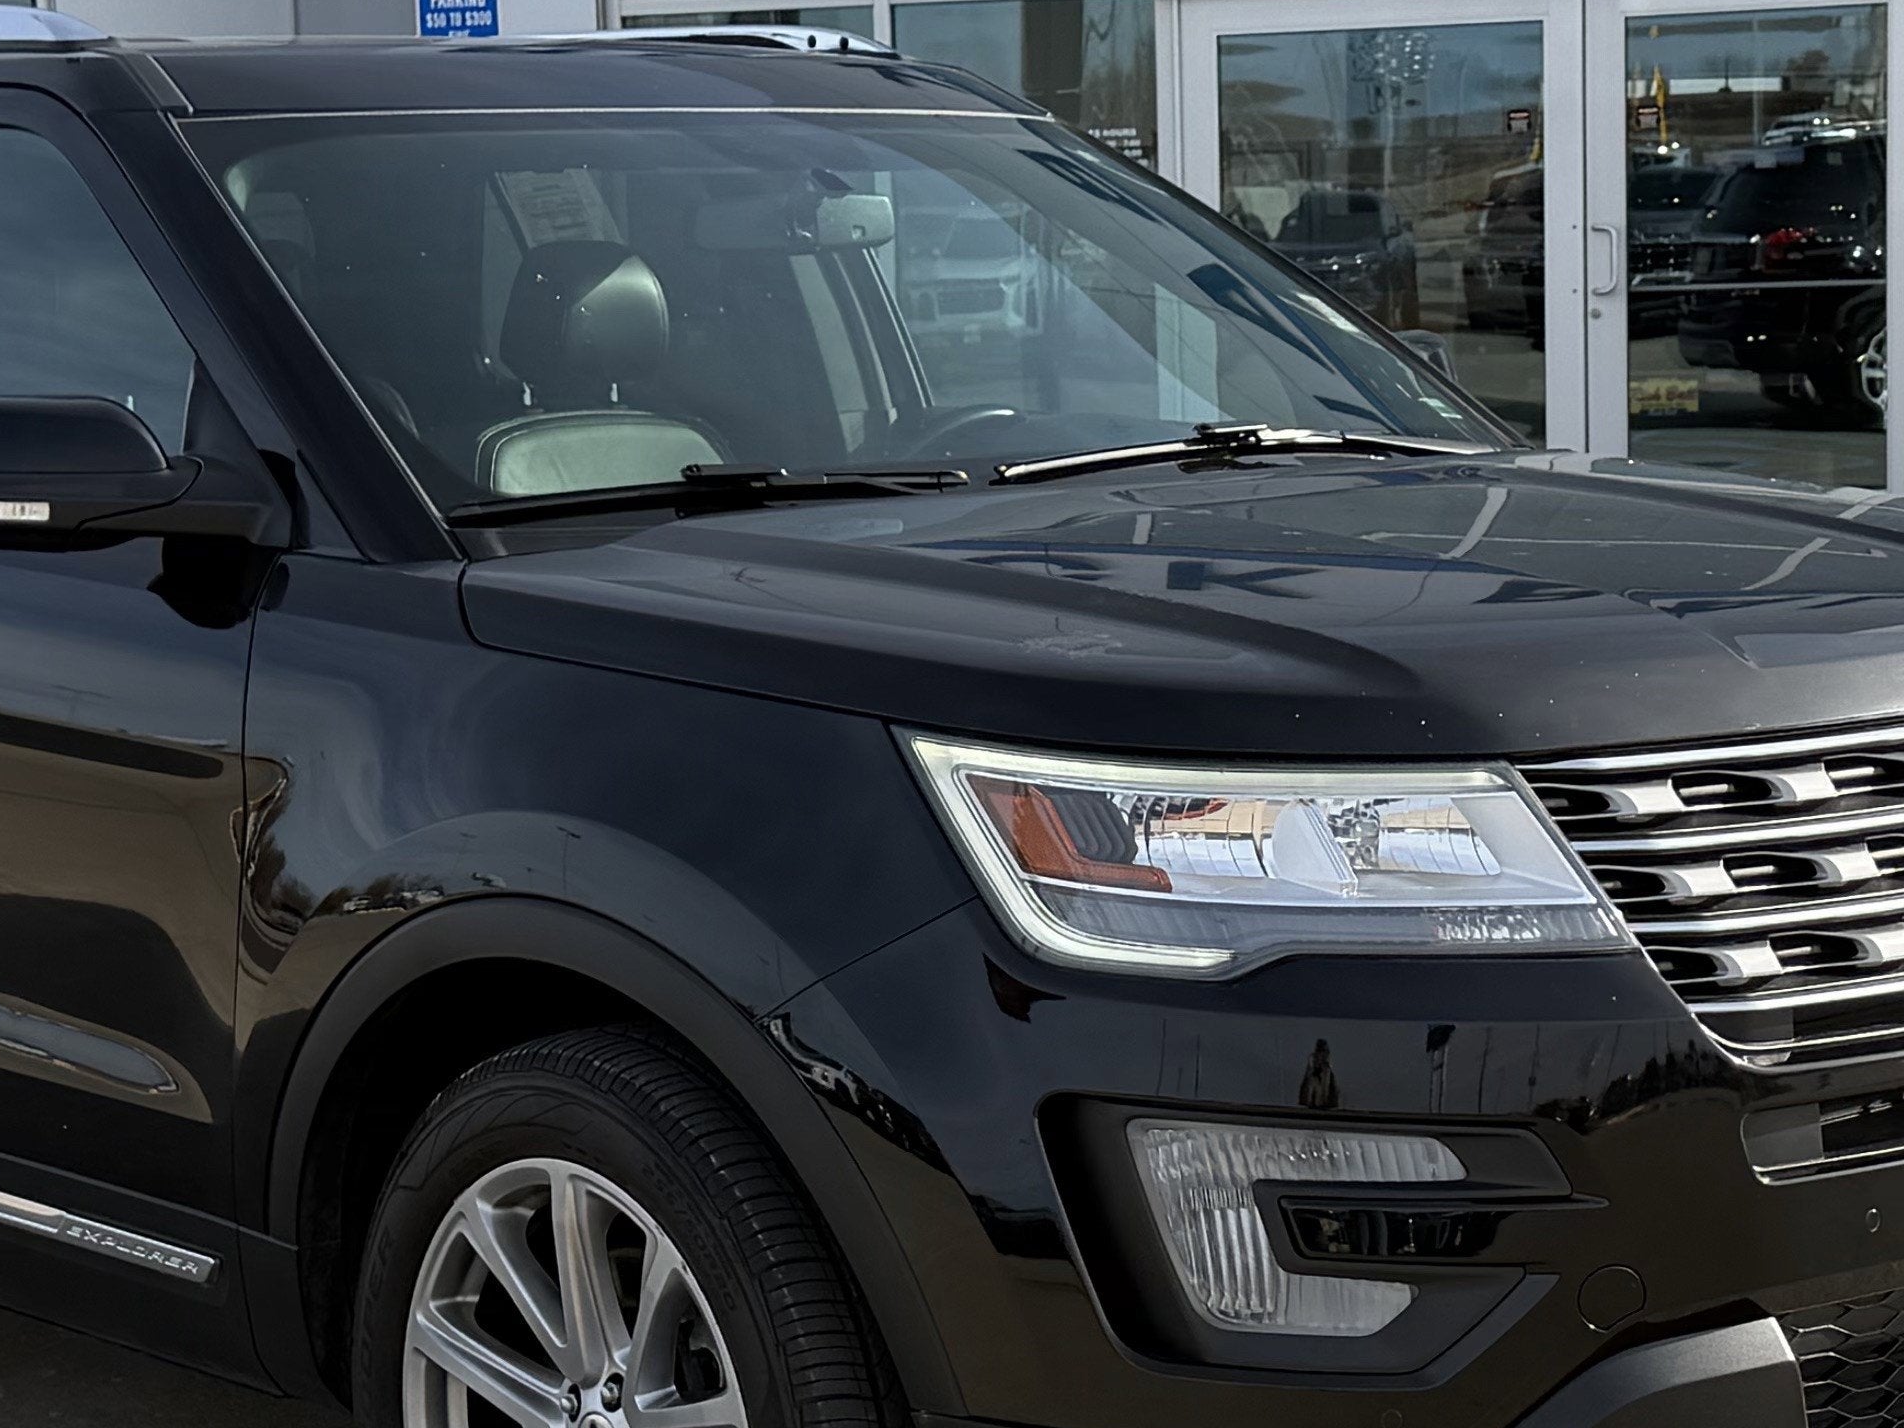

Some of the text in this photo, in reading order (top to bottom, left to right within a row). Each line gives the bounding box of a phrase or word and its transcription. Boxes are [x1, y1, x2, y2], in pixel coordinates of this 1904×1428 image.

[425, 10, 492, 28] $50 TO $300
[65, 1225, 199, 1275] EXPLORER
